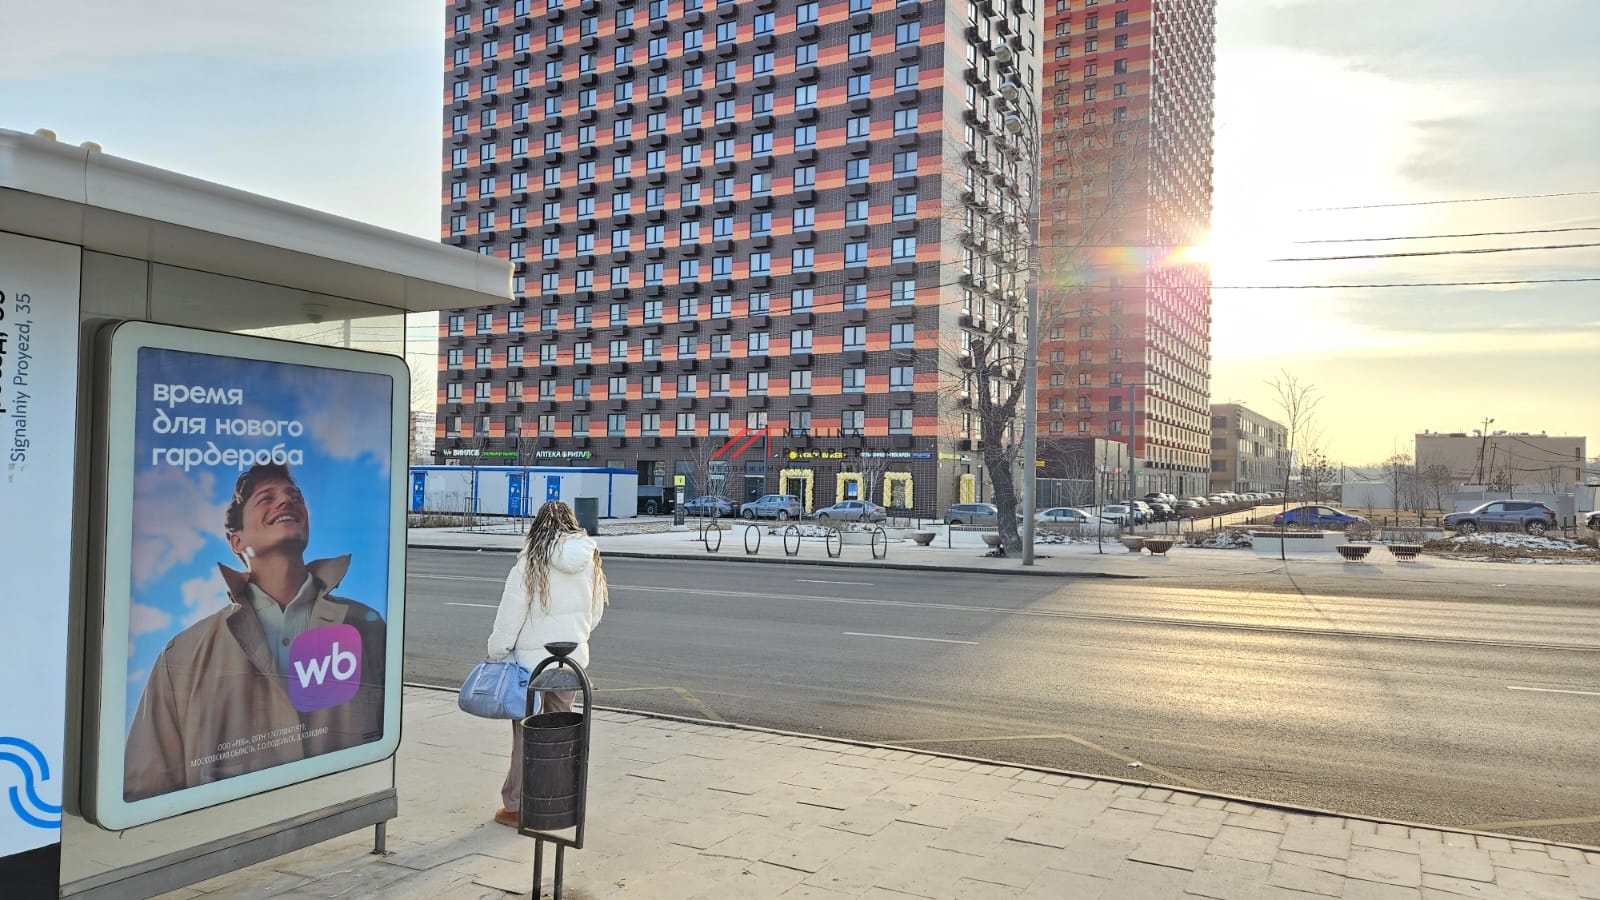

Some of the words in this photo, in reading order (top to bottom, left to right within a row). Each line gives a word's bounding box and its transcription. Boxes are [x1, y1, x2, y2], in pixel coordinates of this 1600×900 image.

[15, 293, 31, 314] 35
[13, 319, 33, 386] Proyezd,
[153, 383, 243, 408] время
[10, 391, 31, 462] Signalniy
[152, 408, 206, 434] для
[215, 417, 304, 437] нового
[152, 441, 303, 472] гардероба
[536, 450, 561, 458] АПТЕКА
[293, 641, 357, 688] wb
